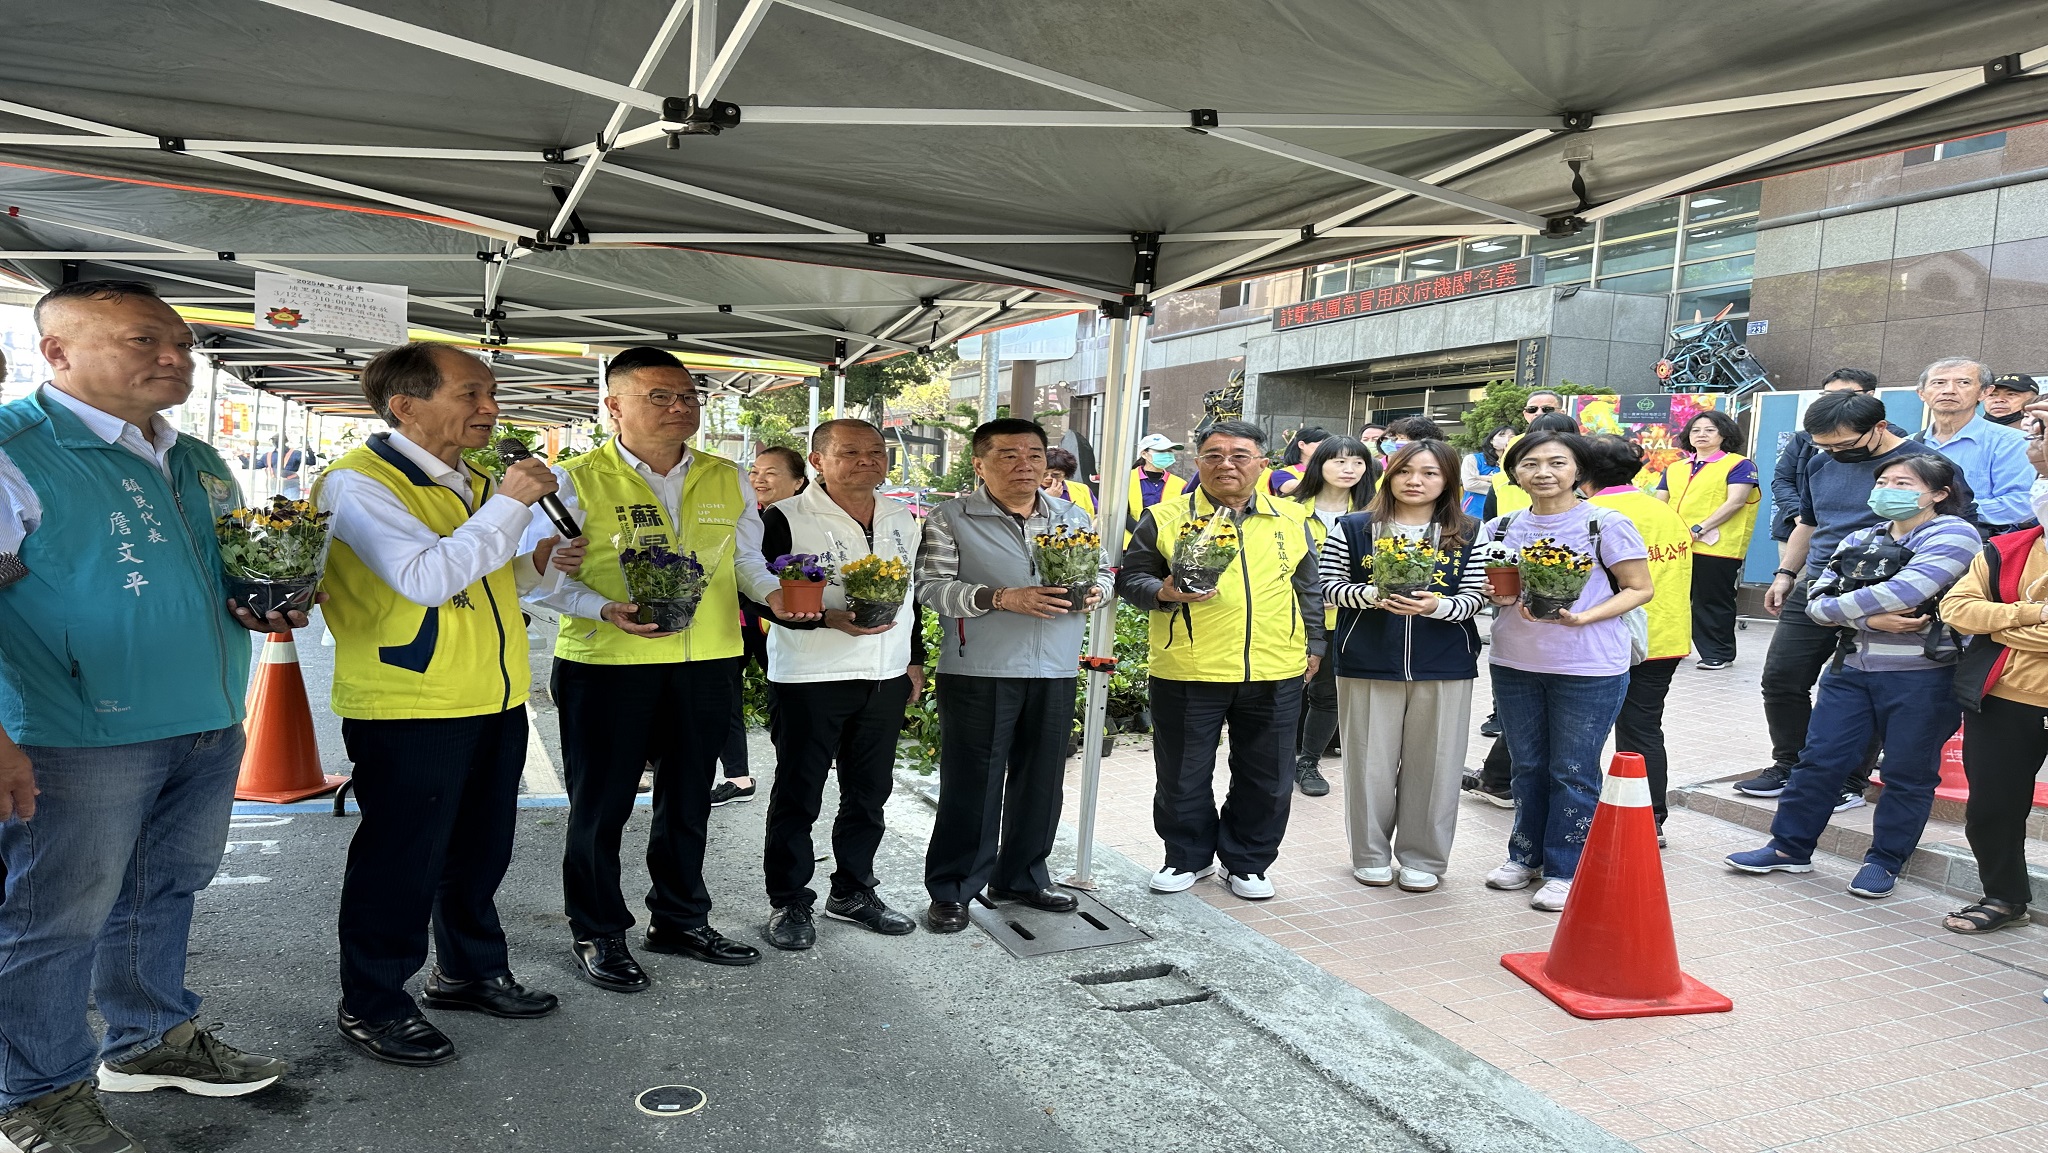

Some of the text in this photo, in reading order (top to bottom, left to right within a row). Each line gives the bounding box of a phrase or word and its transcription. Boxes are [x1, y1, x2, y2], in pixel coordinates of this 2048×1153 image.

[1280, 263, 1517, 327] 詐騙集團常冒用政府機關名義
[1751, 325, 1766, 334] 239
[121, 478, 169, 543] 鎮民代表
[109, 511, 150, 597] 詹文平
[1452, 545, 1463, 577] 法委員
[1647, 541, 1688, 563] 鎮公所
